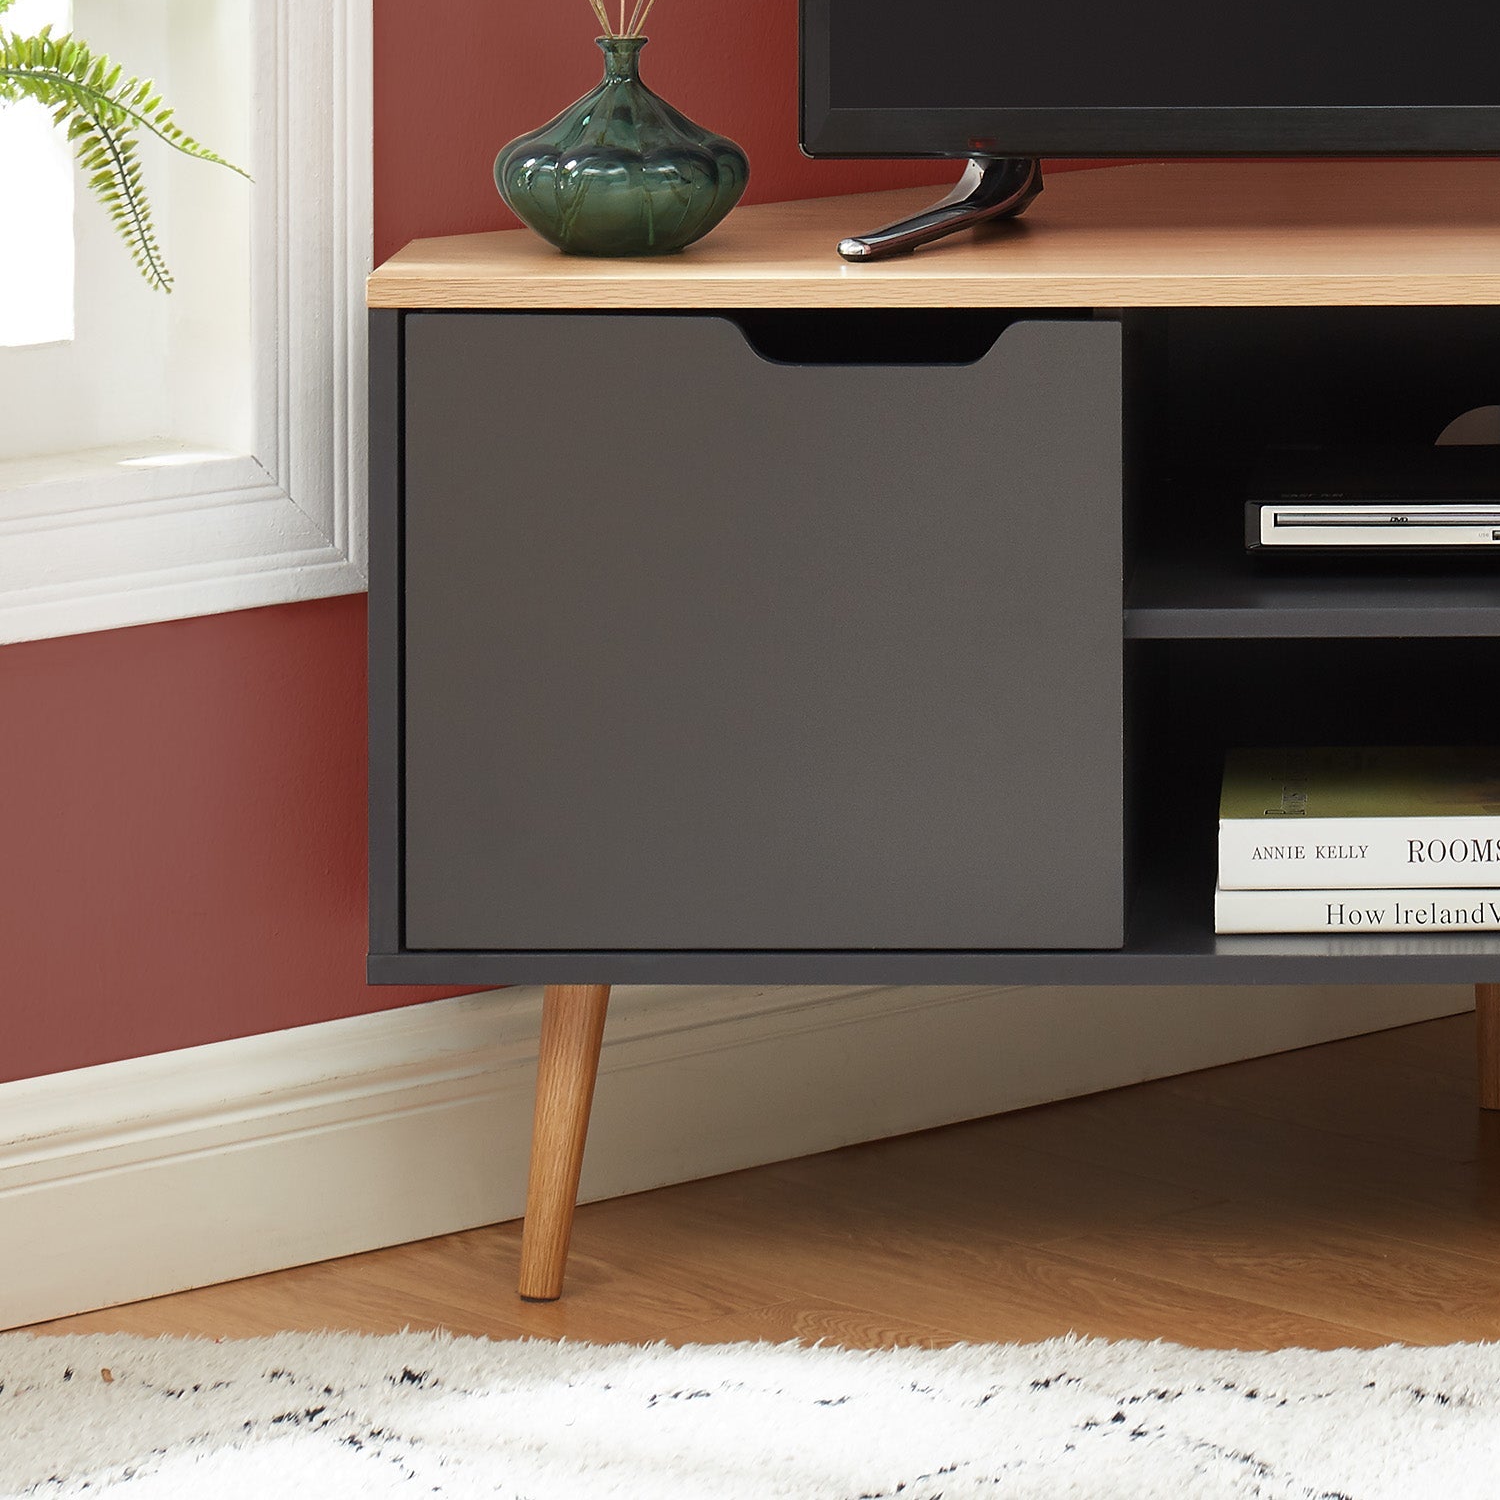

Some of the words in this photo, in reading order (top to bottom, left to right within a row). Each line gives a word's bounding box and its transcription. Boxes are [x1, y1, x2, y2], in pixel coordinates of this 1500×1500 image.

[1252, 845, 1306, 860] ANNIE
[1315, 845, 1369, 859] KELLY
[1326, 903, 1386, 925] How
